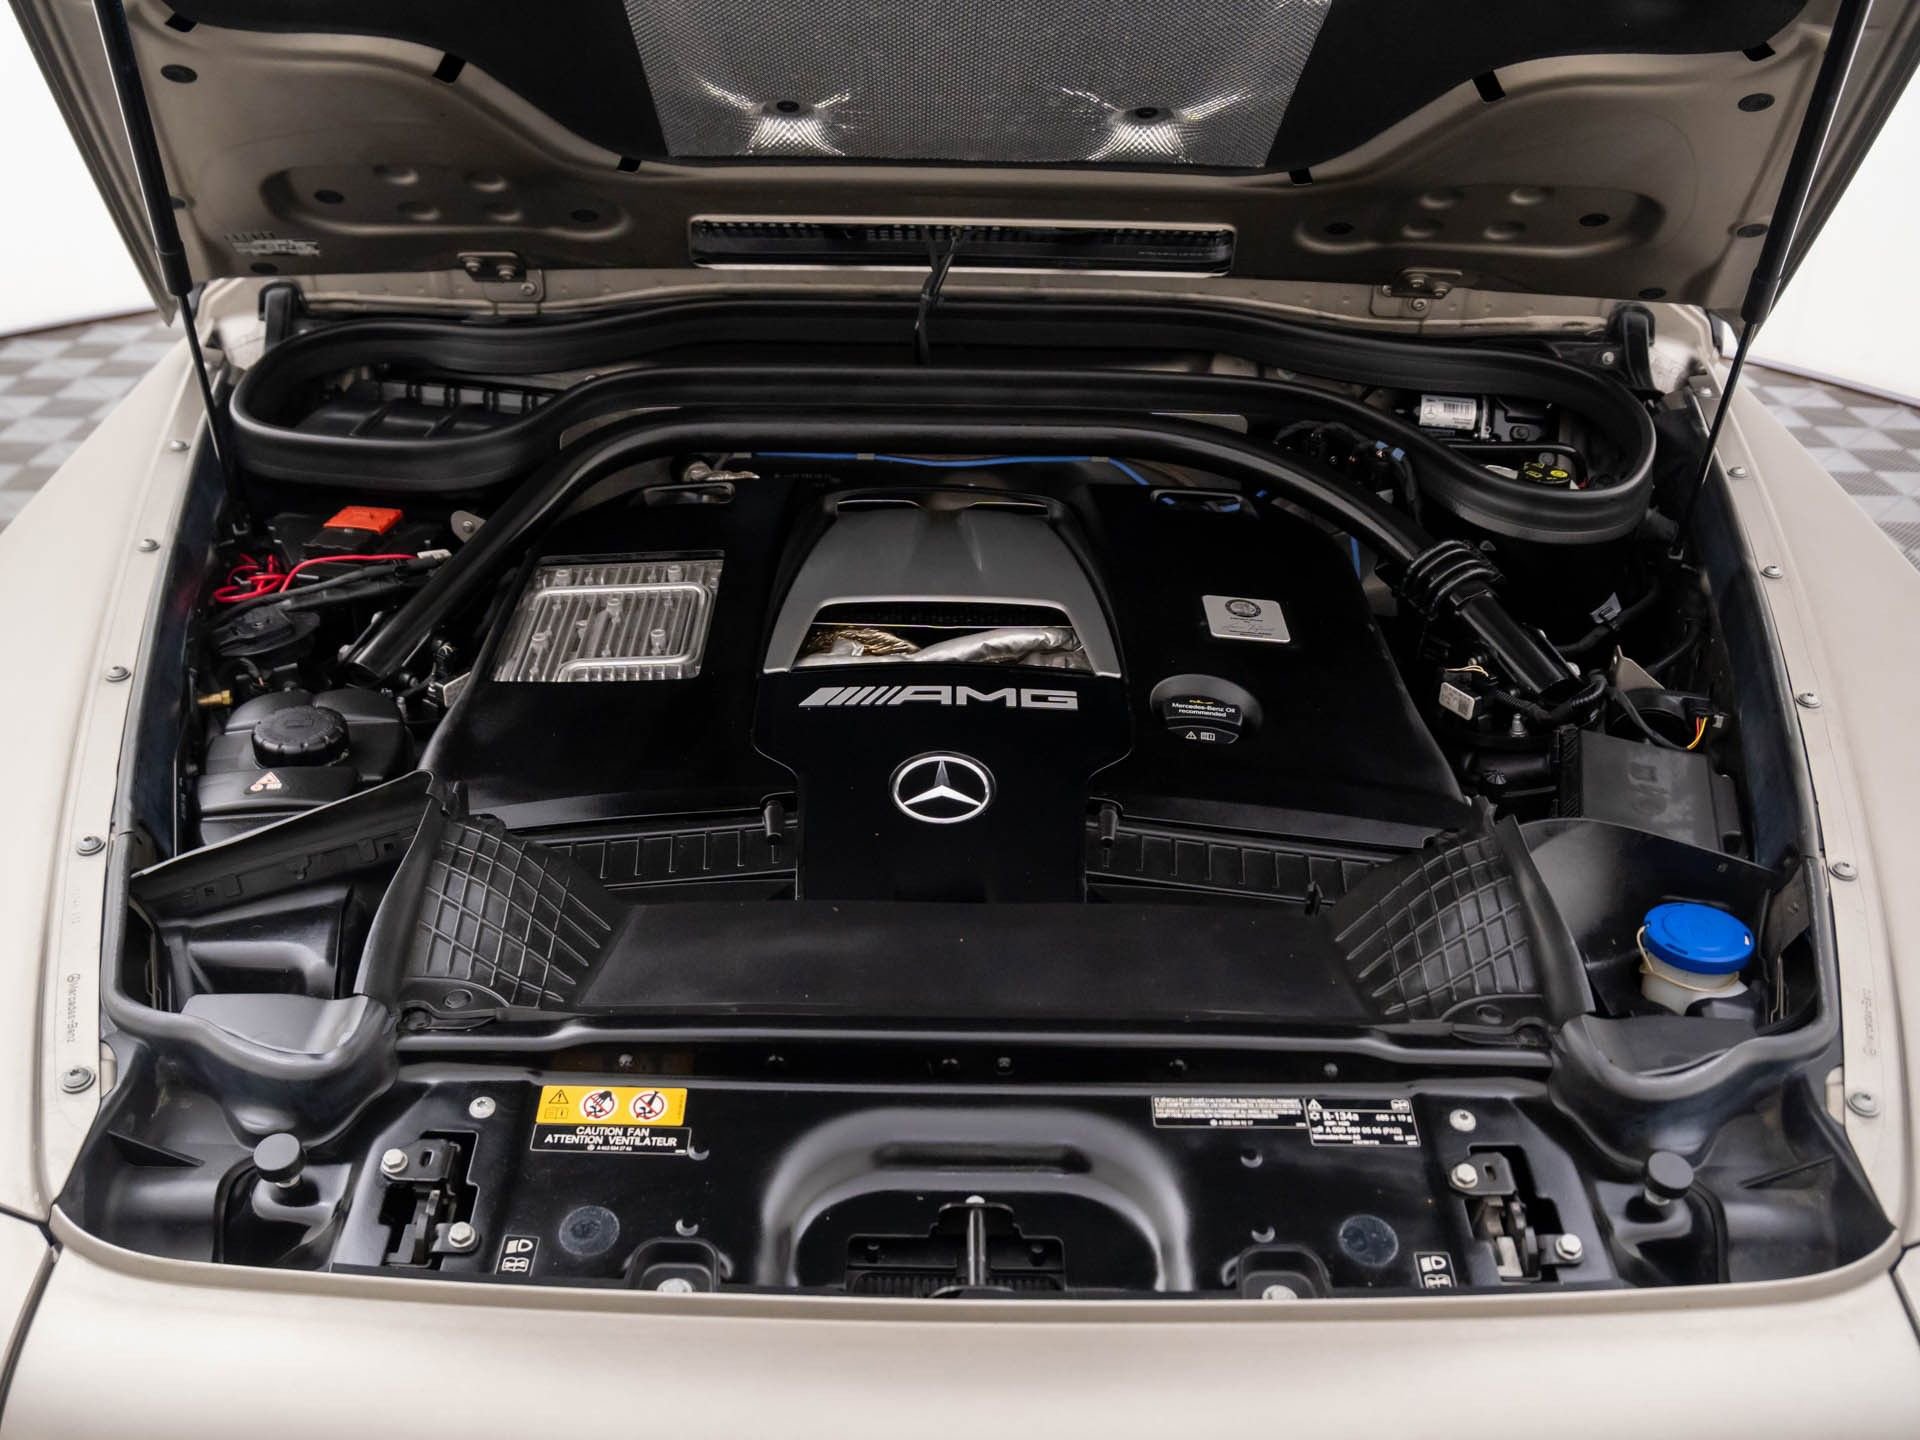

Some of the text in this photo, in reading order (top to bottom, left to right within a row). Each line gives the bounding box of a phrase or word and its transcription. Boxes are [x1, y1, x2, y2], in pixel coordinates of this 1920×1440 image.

[887, 685, 1079, 711] AMG
[1171, 702, 1225, 713] Mercedes-Benz
[1178, 708, 1227, 718] recommended
[576, 1126, 650, 1137] CAUTION FAN
[544, 1133, 678, 1147] ATTENTION VENTILATEUR
